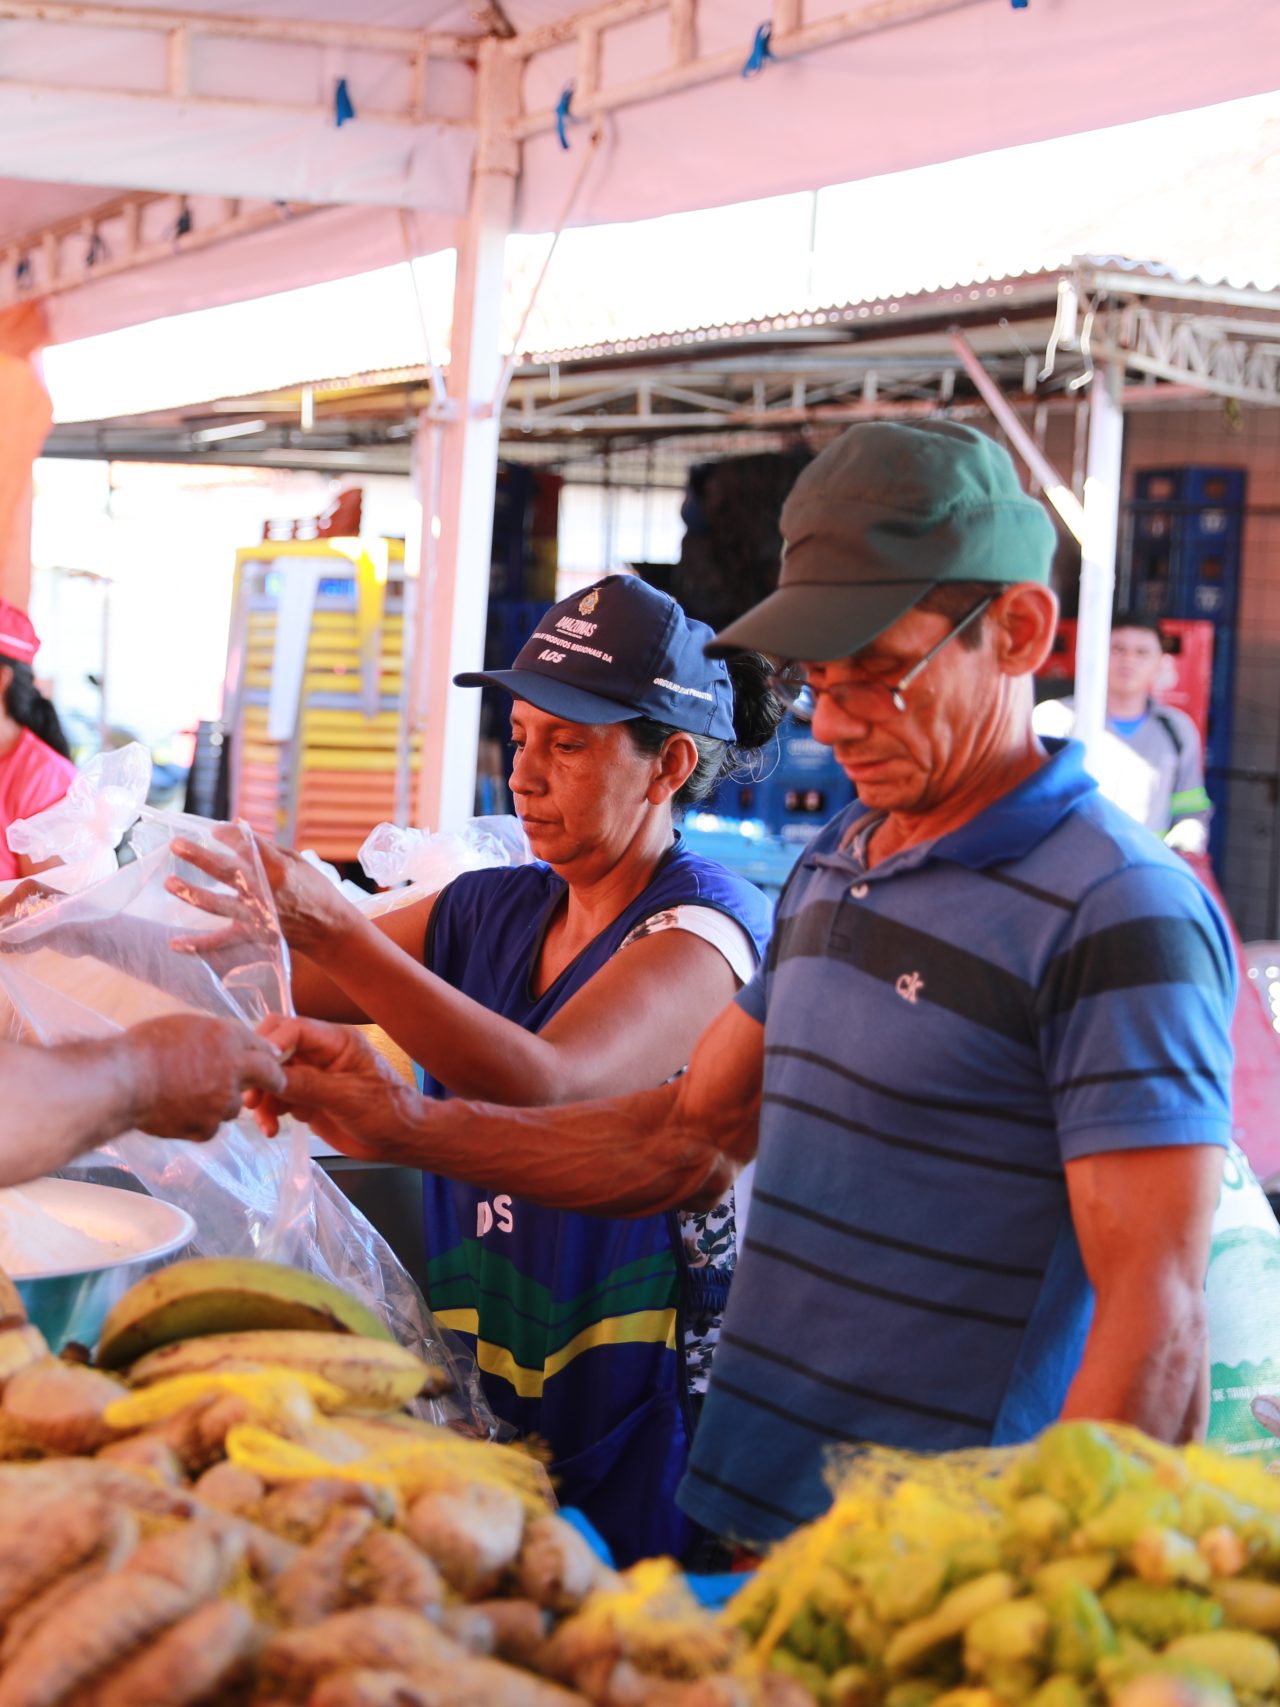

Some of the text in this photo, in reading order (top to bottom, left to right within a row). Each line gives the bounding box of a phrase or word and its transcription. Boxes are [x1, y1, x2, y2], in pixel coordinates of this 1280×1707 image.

[555, 616, 598, 637] AMAZONAS
[538, 649, 567, 664] ADS
[601, 653, 613, 664] DA
